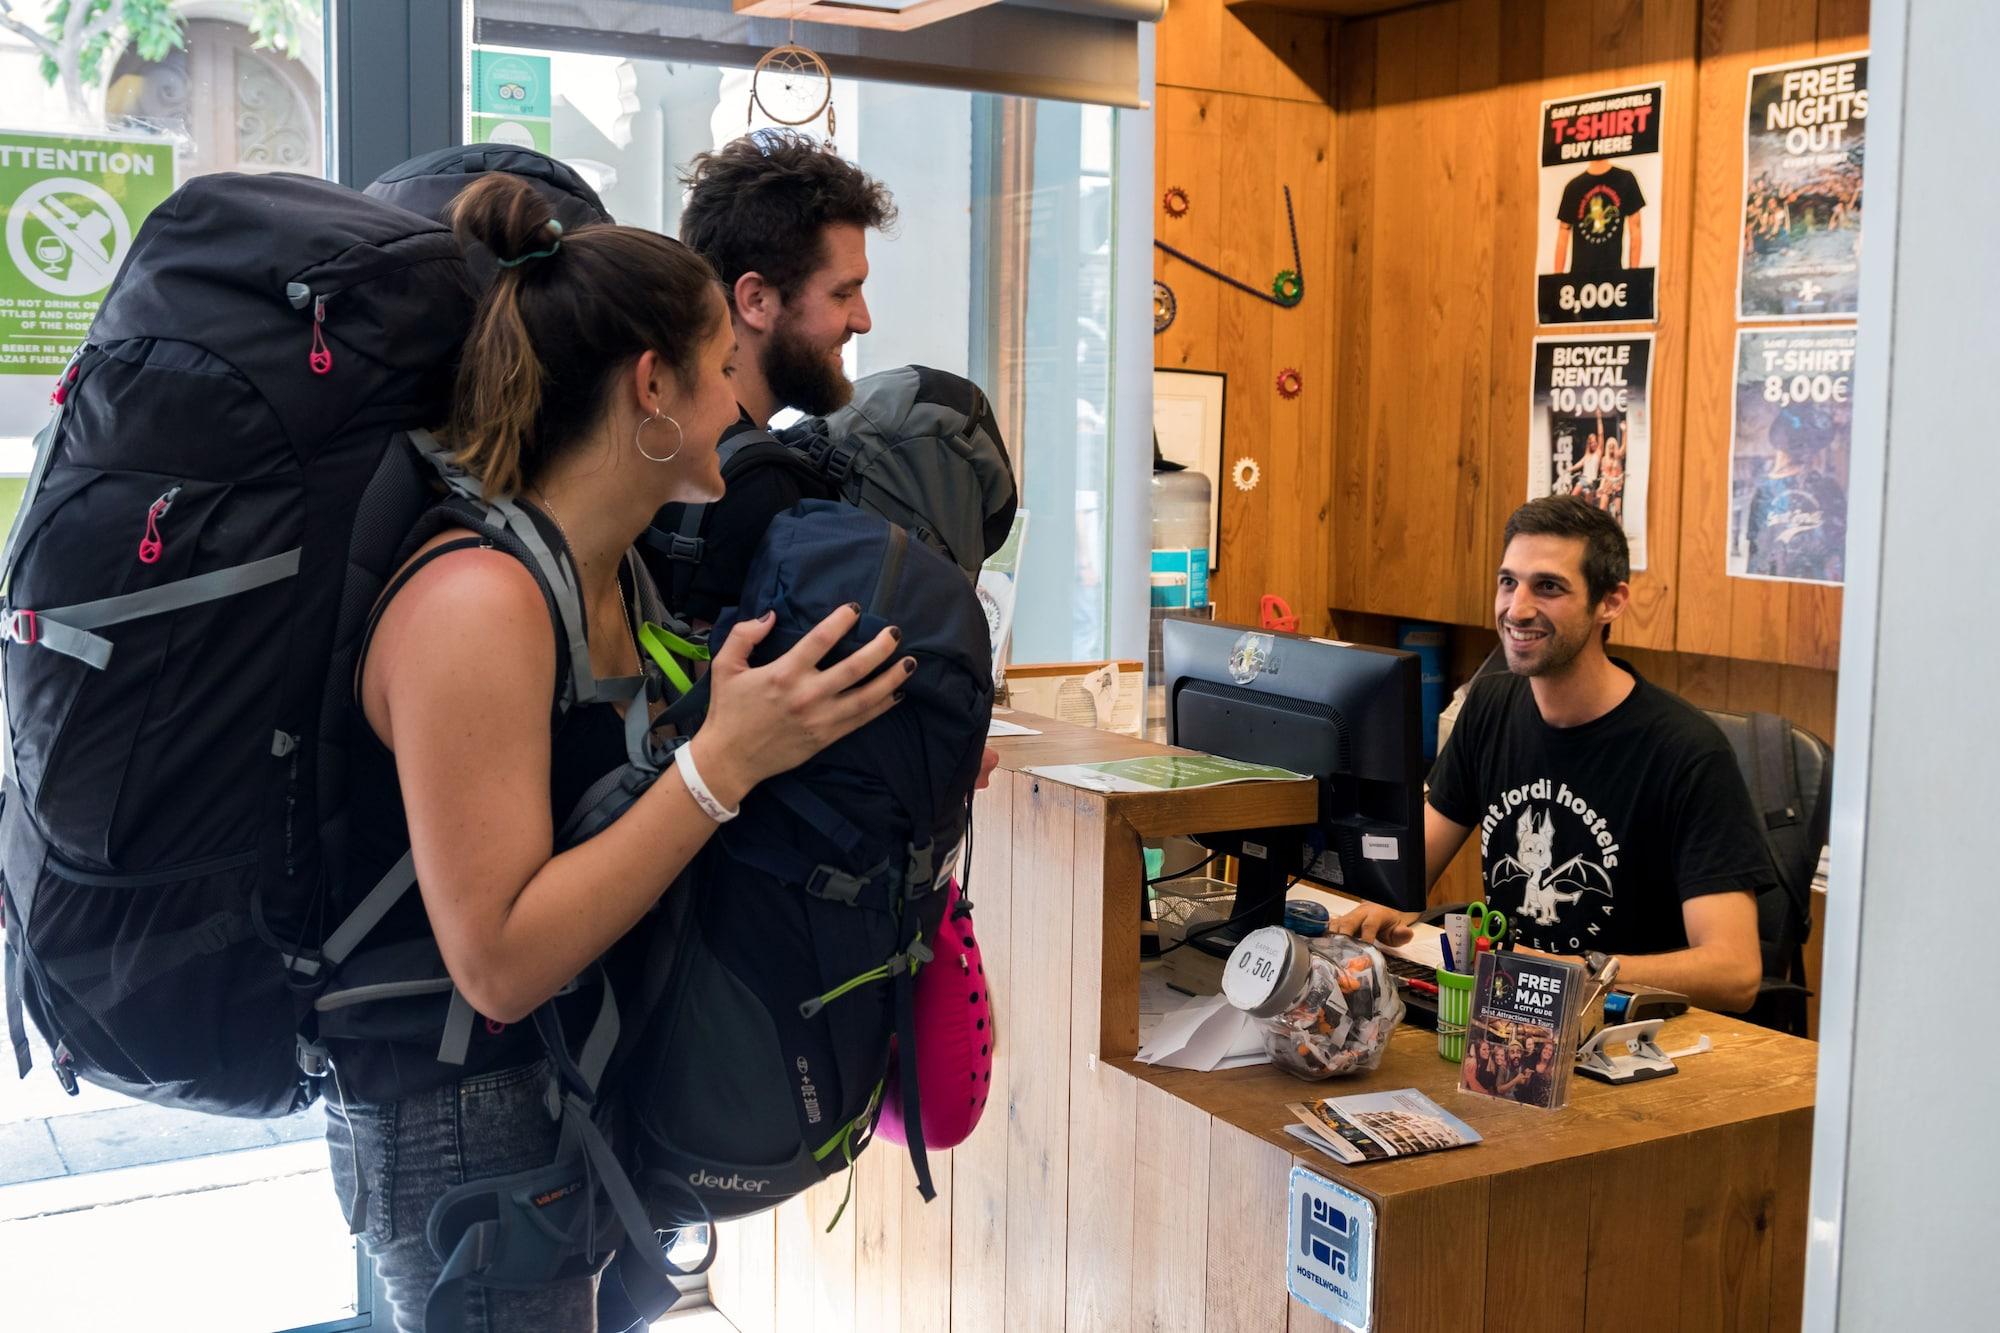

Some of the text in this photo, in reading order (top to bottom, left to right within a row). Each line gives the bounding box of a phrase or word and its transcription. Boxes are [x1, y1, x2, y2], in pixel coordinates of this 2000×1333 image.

[1782, 63, 1856, 101] FREE
[1766, 89, 1869, 131] NIGHTS
[1551, 106, 1652, 145] T-SHIRT
[1561, 135, 1633, 160] BUY HERE
[1785, 121, 1848, 156] OUT
[17, 299, 41, 308] NOT
[44, 300, 80, 309] DRINK
[1559, 282, 1628, 314] 8,00€
[21, 321, 36, 329] OF
[39, 321, 62, 330] THE
[40, 310, 63, 319] AND
[1552, 345, 1630, 367] BICYCLE
[1762, 349, 1856, 372] T-SHIRT
[1551, 366, 1628, 388] RENTAL
[1550, 387, 1628, 417] 10,00€
[1763, 374, 1849, 408] 8,00€
[1501, 778, 1552, 816] jordi
[1556, 783, 1620, 869] hostels
[1518, 972, 1561, 994] FREE
[1515, 988, 1553, 1008] MAP
[1496, 1011, 1531, 1023] Attractions
[1534, 1008, 1552, 1016] GUDE
[689, 1169, 770, 1193] deuter
[1296, 1264, 1348, 1300] HOSTELWORLD
